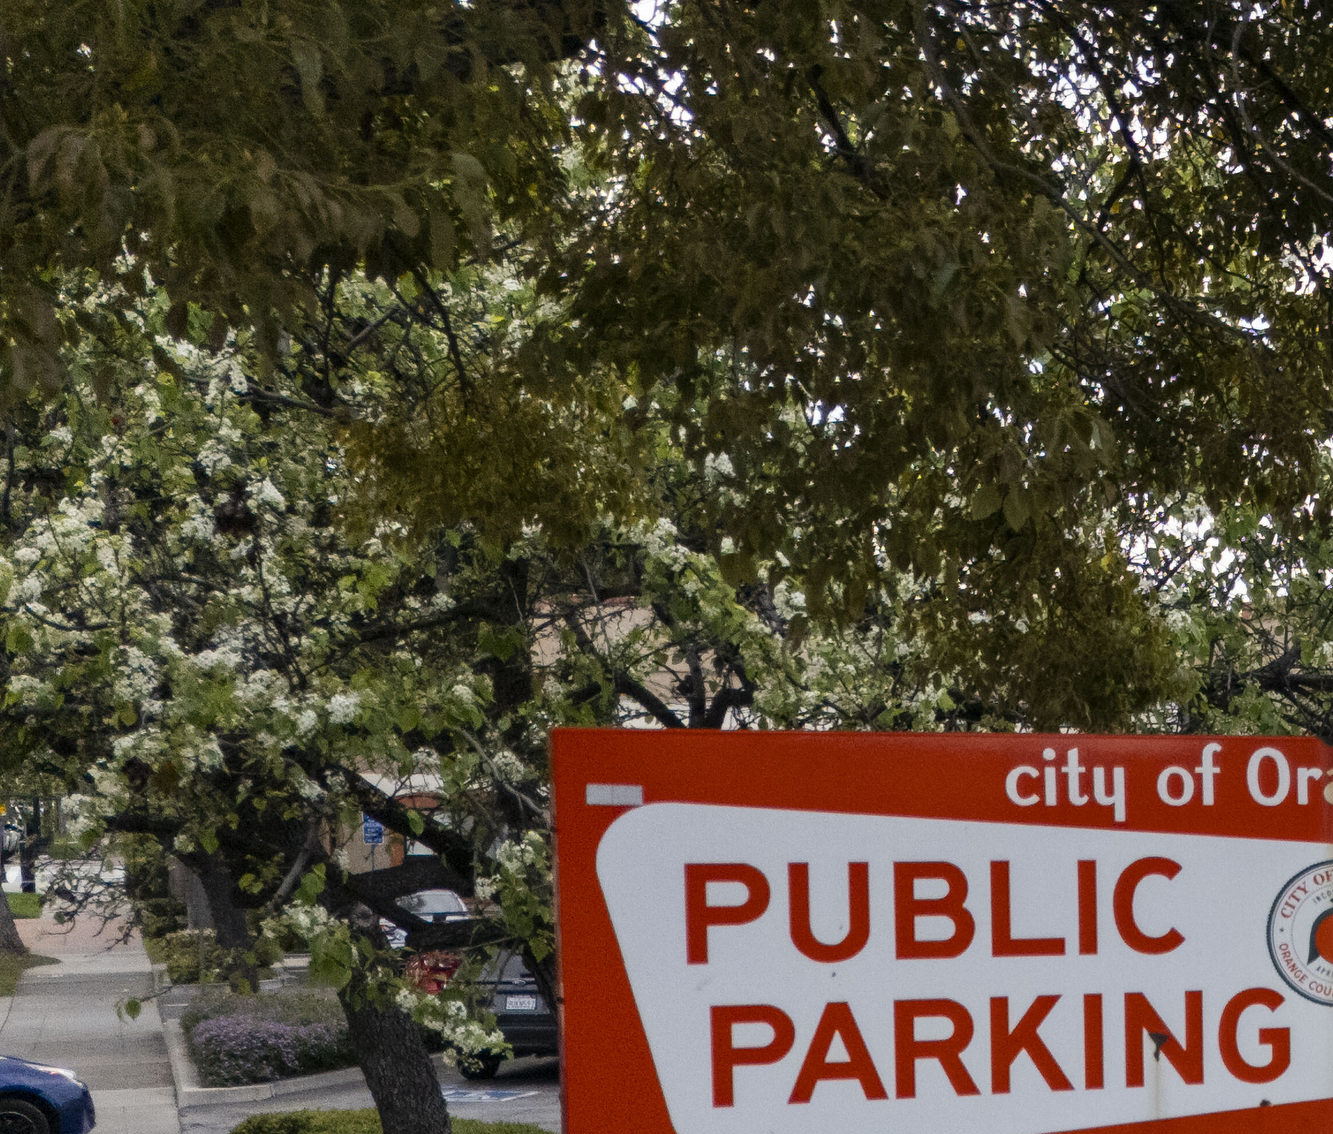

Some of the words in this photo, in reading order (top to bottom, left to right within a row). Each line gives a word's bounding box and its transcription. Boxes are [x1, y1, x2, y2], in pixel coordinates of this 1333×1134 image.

[1005, 746, 1126, 823] city
[1156, 742, 1222, 806] of
[683, 855, 1186, 965] PUBLIC
[1280, 881, 1310, 919] CITY
[1279, 943, 1308, 985] ORANGE
[709, 987, 1291, 1108] PARKING
